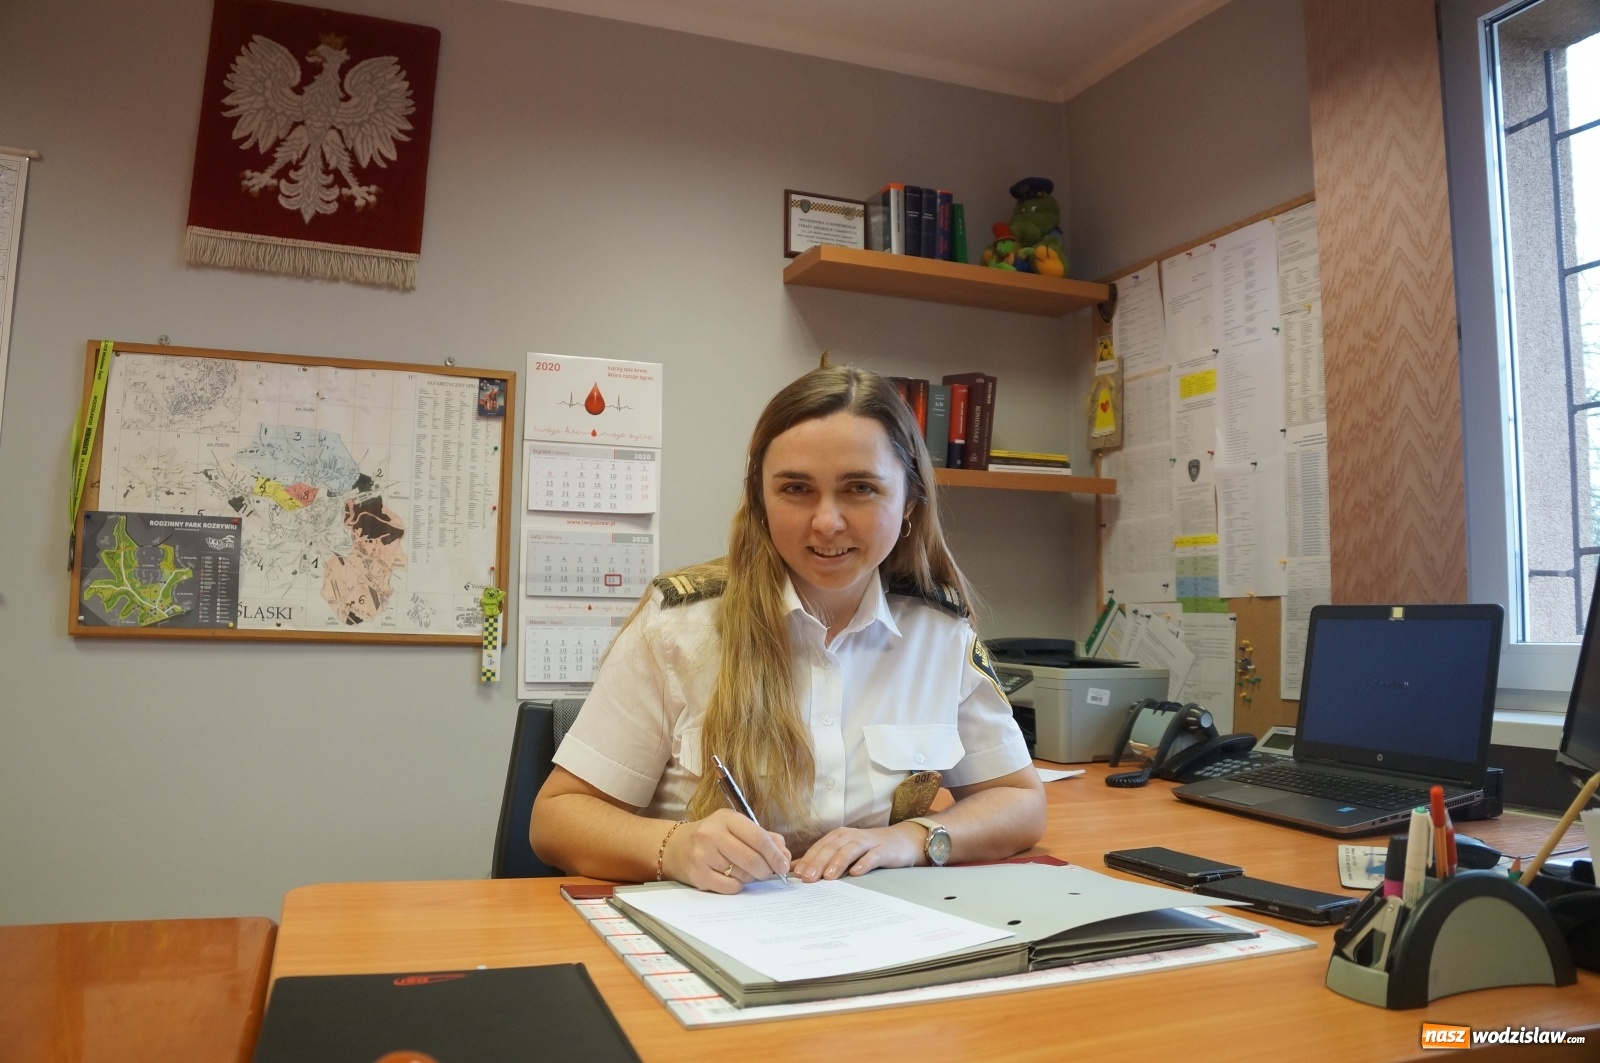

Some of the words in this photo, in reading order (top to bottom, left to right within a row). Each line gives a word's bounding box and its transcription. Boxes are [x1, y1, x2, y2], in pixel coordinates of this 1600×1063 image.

[535, 361, 561, 372] 2020
[973, 405, 982, 443] KOMENTARZ
[292, 432, 302, 441] 3
[375, 468, 384, 478] 2
[303, 490, 309, 499] 8
[202, 522, 237, 530] ROZRYWKI
[256, 559, 264, 571] 4
[311, 556, 319, 569] 1
[358, 594, 365, 604] 6
[237, 601, 293, 622] ŚLĄSKI
